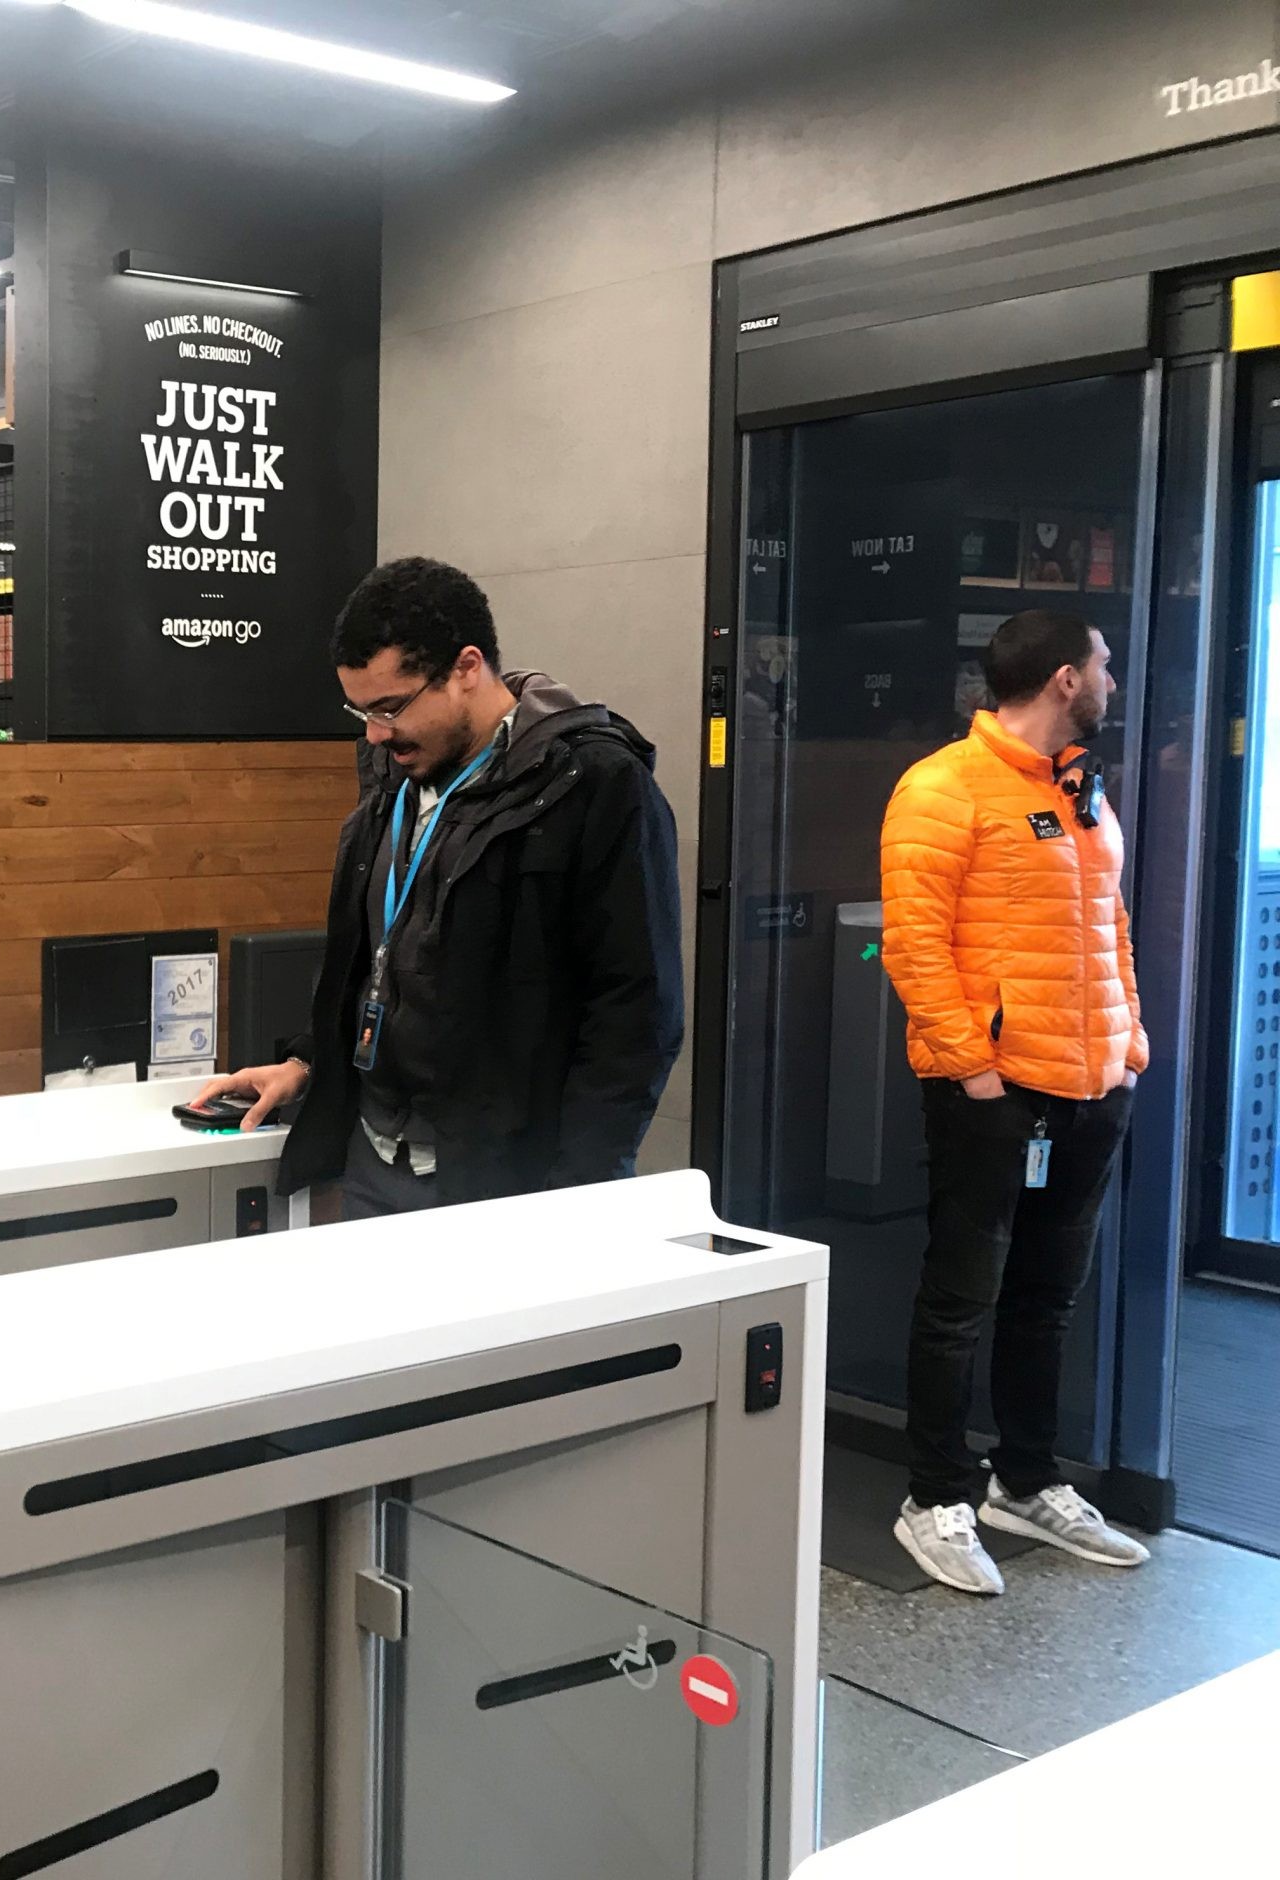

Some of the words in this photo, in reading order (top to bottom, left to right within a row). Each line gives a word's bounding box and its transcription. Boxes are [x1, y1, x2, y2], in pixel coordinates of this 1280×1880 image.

[1161, 59, 1280, 116] Thank
[144, 320, 165, 342] NO
[164, 314, 202, 337] LINES.
[203, 314, 221, 335] NO
[222, 317, 284, 359] CHECKOUT.
[740, 316, 779, 331] STANLEY
[198, 344, 252, 366] SERIOUSLY.)
[156, 380, 276, 436] JUST
[140, 433, 284, 490] WALK
[159, 491, 265, 542] OUT
[147, 545, 276, 574] SHOPPING
[161, 617, 233, 643] amazon
[234, 620, 261, 644] go
[167, 968, 203, 1006] 2017
